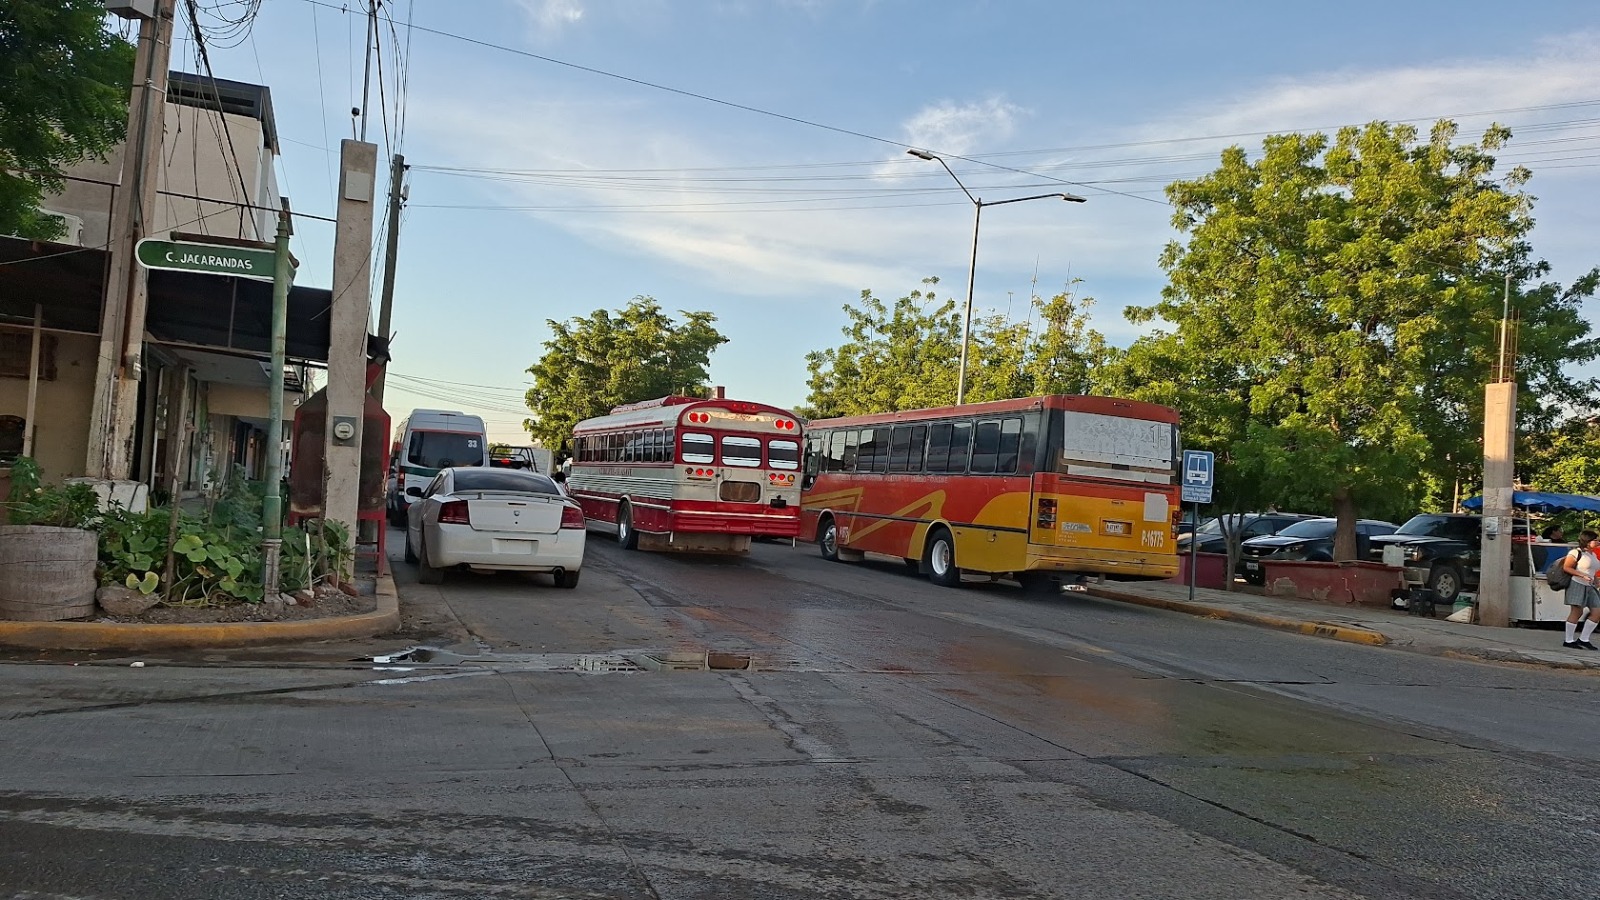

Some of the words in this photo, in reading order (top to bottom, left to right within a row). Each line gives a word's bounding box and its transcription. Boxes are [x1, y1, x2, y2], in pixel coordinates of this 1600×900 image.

[165, 251, 178, 263] C.
[180, 253, 253, 270] JACARANDAS
[467, 440, 478, 448] 33
